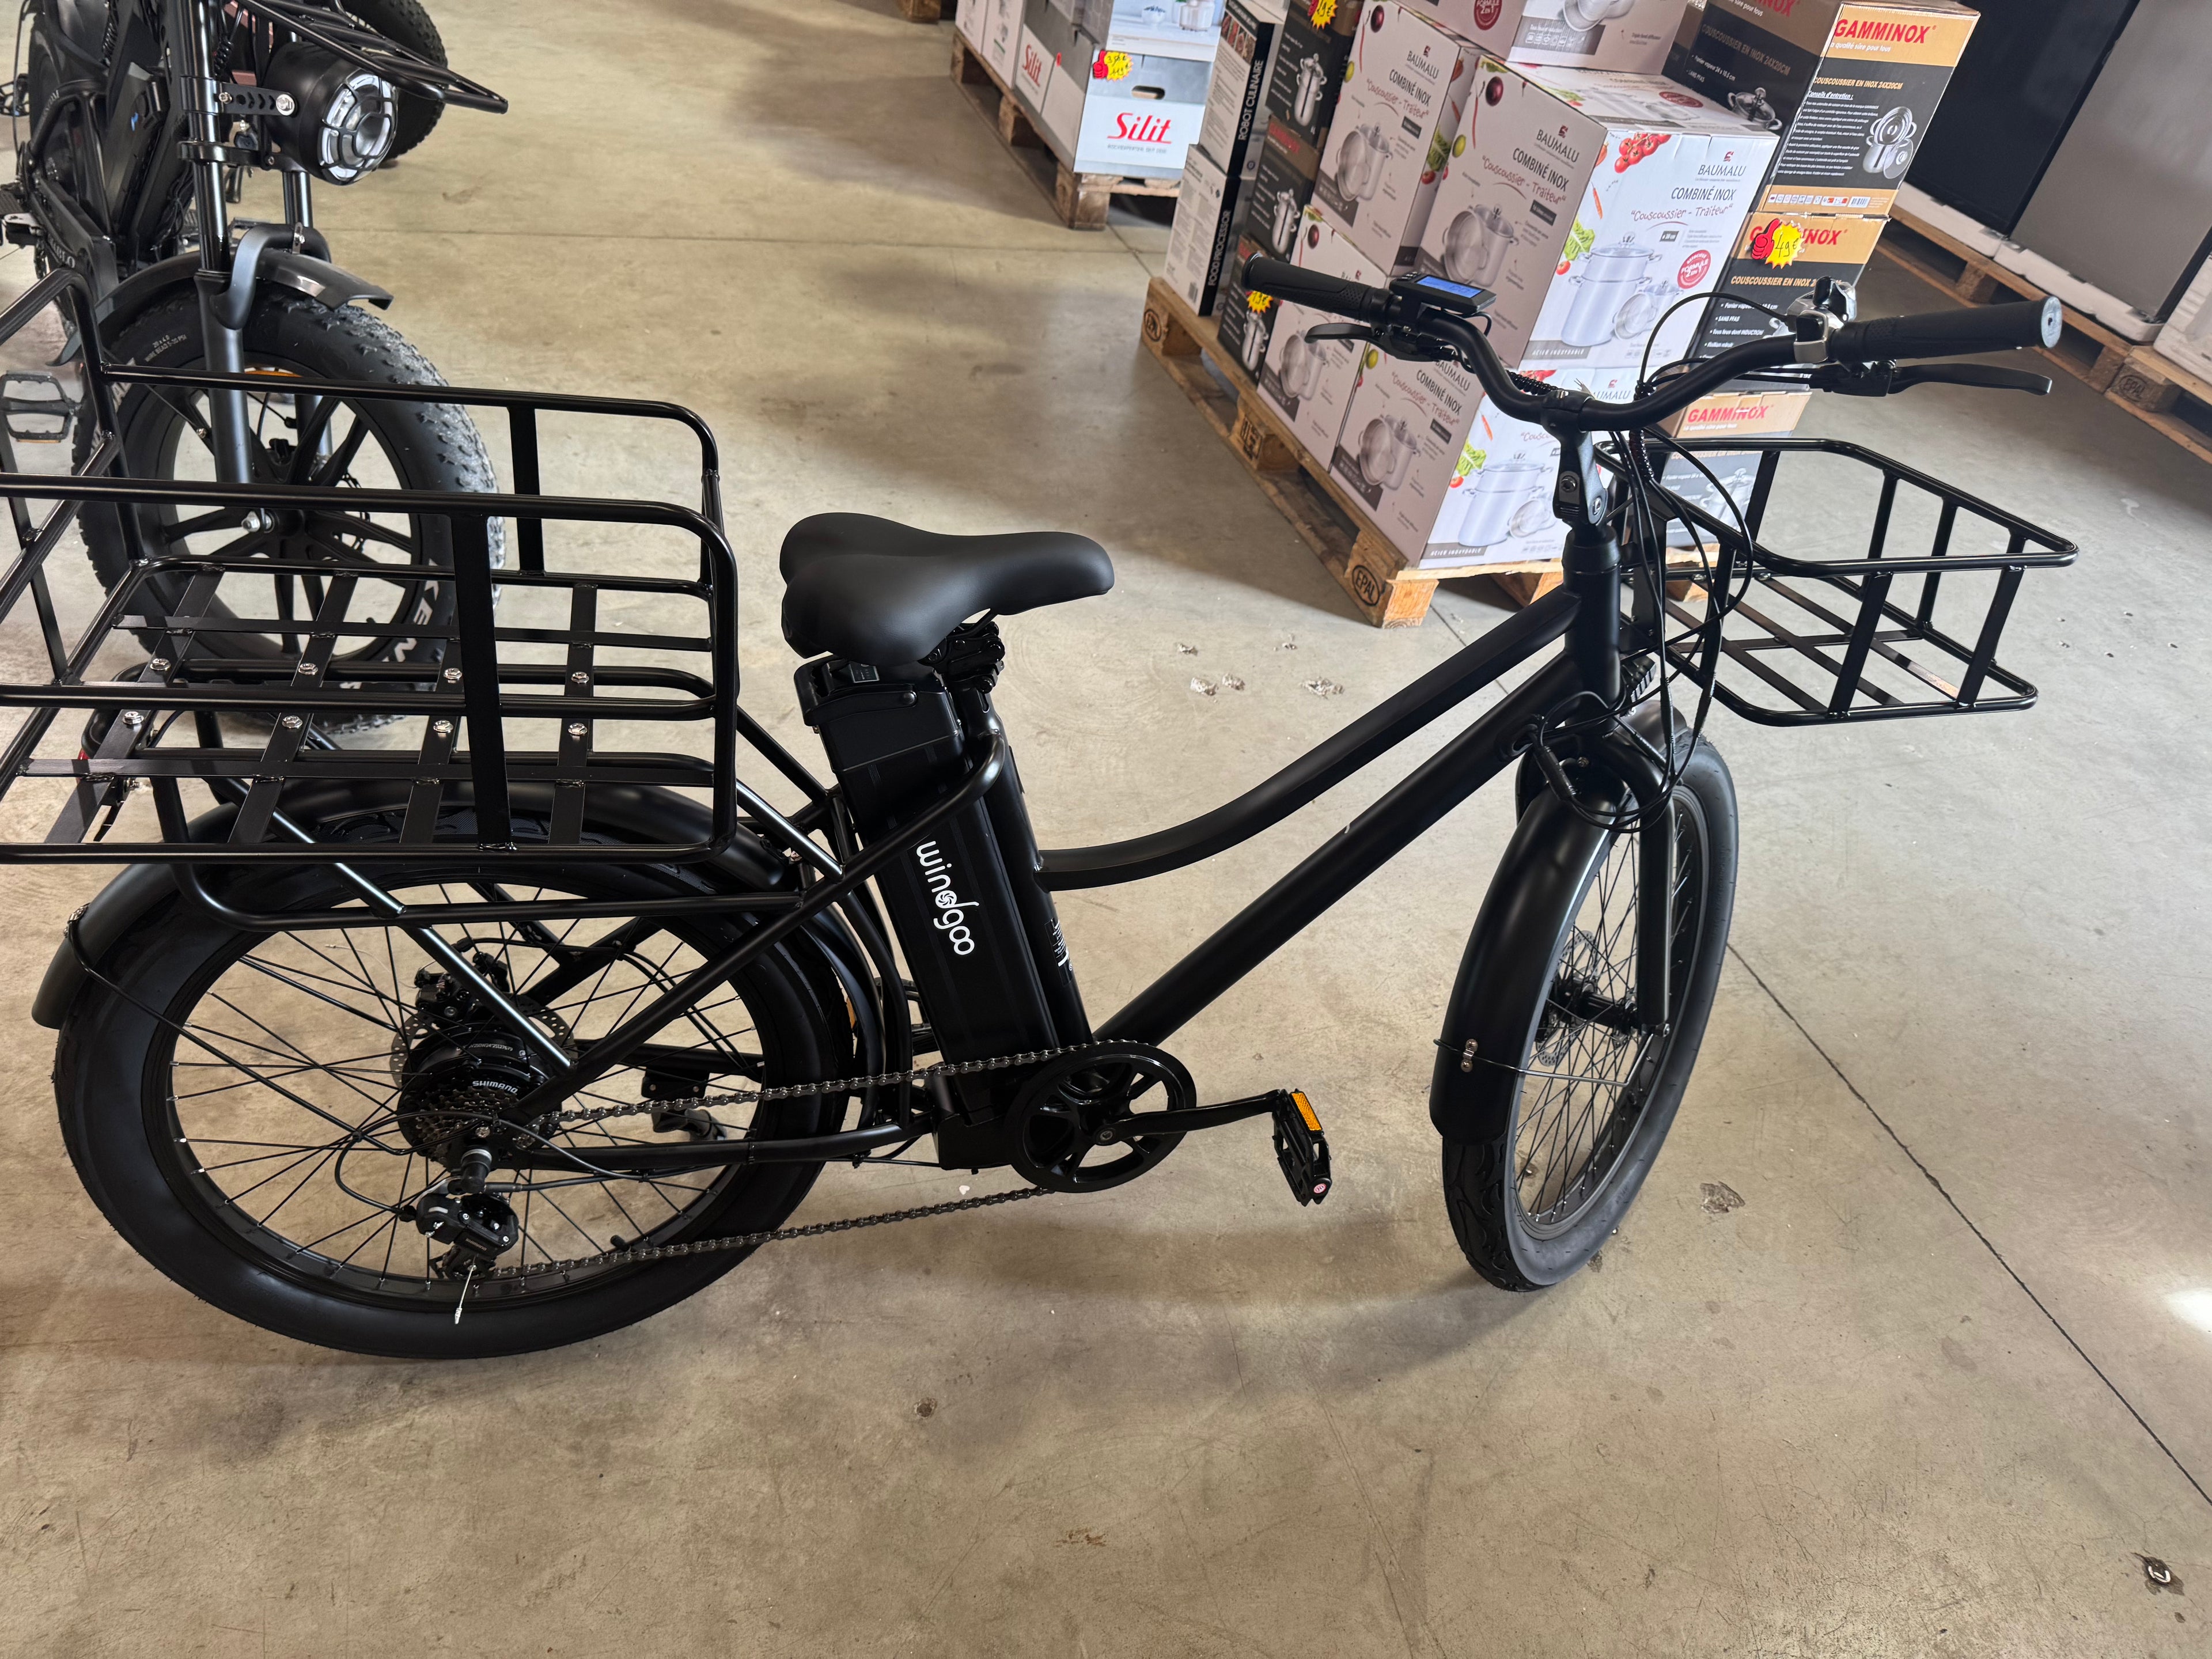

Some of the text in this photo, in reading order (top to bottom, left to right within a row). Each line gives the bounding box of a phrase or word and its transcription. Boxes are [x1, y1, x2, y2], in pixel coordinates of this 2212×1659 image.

[1835, 19, 1931, 43] GAMMINOX
[1407, 51, 1439, 79] BAUMALU
[1749, 48, 1766, 64] INOX
[1389, 69, 1417, 96] COMBINÉ
[1415, 87, 1431, 107] INOX
[1863, 80, 1878, 88] INOX
[1238, 60, 1264, 141] ROBOT CULINAIRE
[1107, 112, 1172, 144] Silit
[1536, 129, 1580, 162] BAUMALU
[1513, 147, 1550, 179] COMBINÉ
[1547, 169, 1569, 192] INOX
[1698, 165, 1747, 176] BAUMALU
[1671, 185, 1737, 201] COMBINÉ INOX
[1208, 210, 1231, 286] FOOD PROCESSOR
[1731, 276, 1782, 286] COUSCOUSSIER
[1782, 277, 1792, 286] EN
[1793, 278, 1810, 287] INOX
[1435, 360, 1470, 391] BAUMALU
[1416, 370, 1446, 402] COMBINÉ
[1444, 394, 1462, 416] INOX
[1593, 391, 1631, 400] UMALU
[1688, 406, 1768, 423] GAMMINOX
[1355, 570, 1375, 603] EPAL
[472, 1081, 518, 1094] SHIMANO
